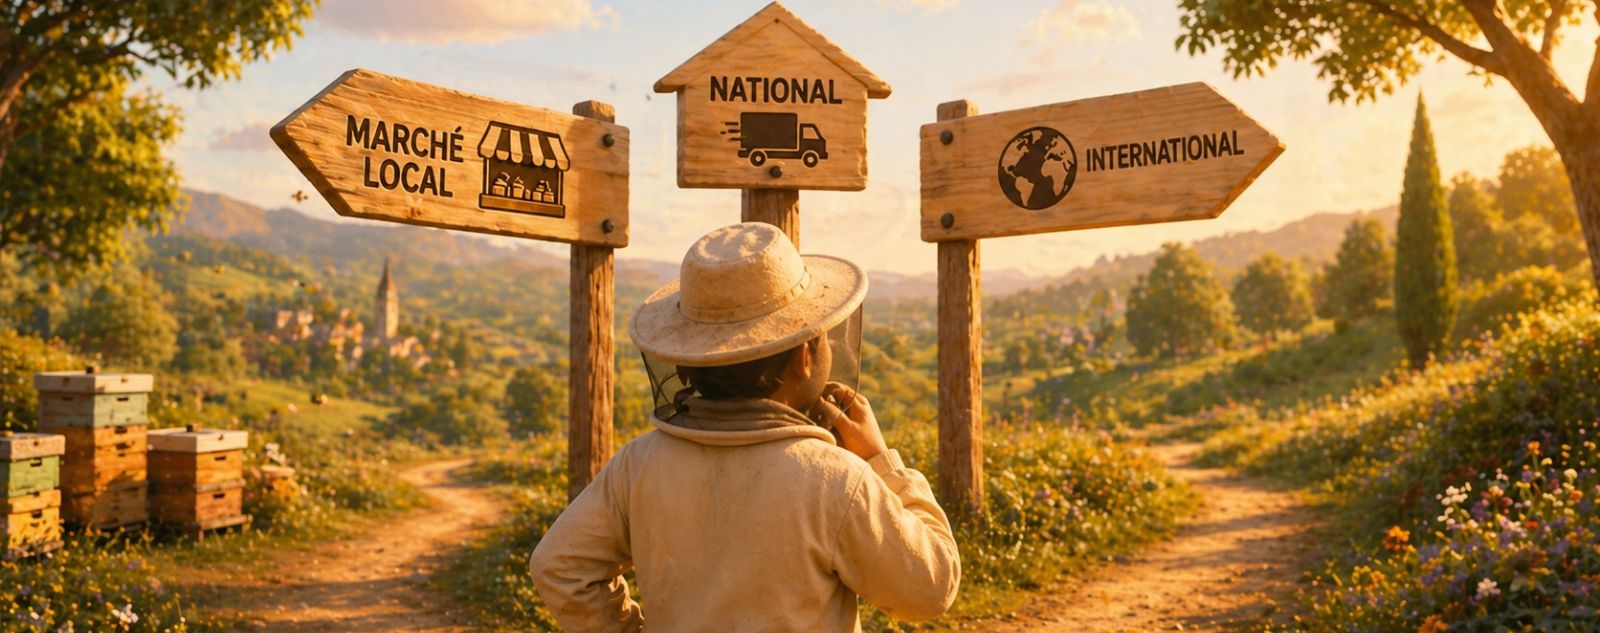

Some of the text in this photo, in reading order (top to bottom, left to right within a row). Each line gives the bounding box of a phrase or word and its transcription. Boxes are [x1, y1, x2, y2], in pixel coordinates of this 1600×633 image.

[710, 75, 843, 104] NATIONAL
[346, 114, 464, 163] MARCHÉ
[1086, 130, 1245, 173] INTERNATIONAL
[364, 156, 453, 198] LOCAL
